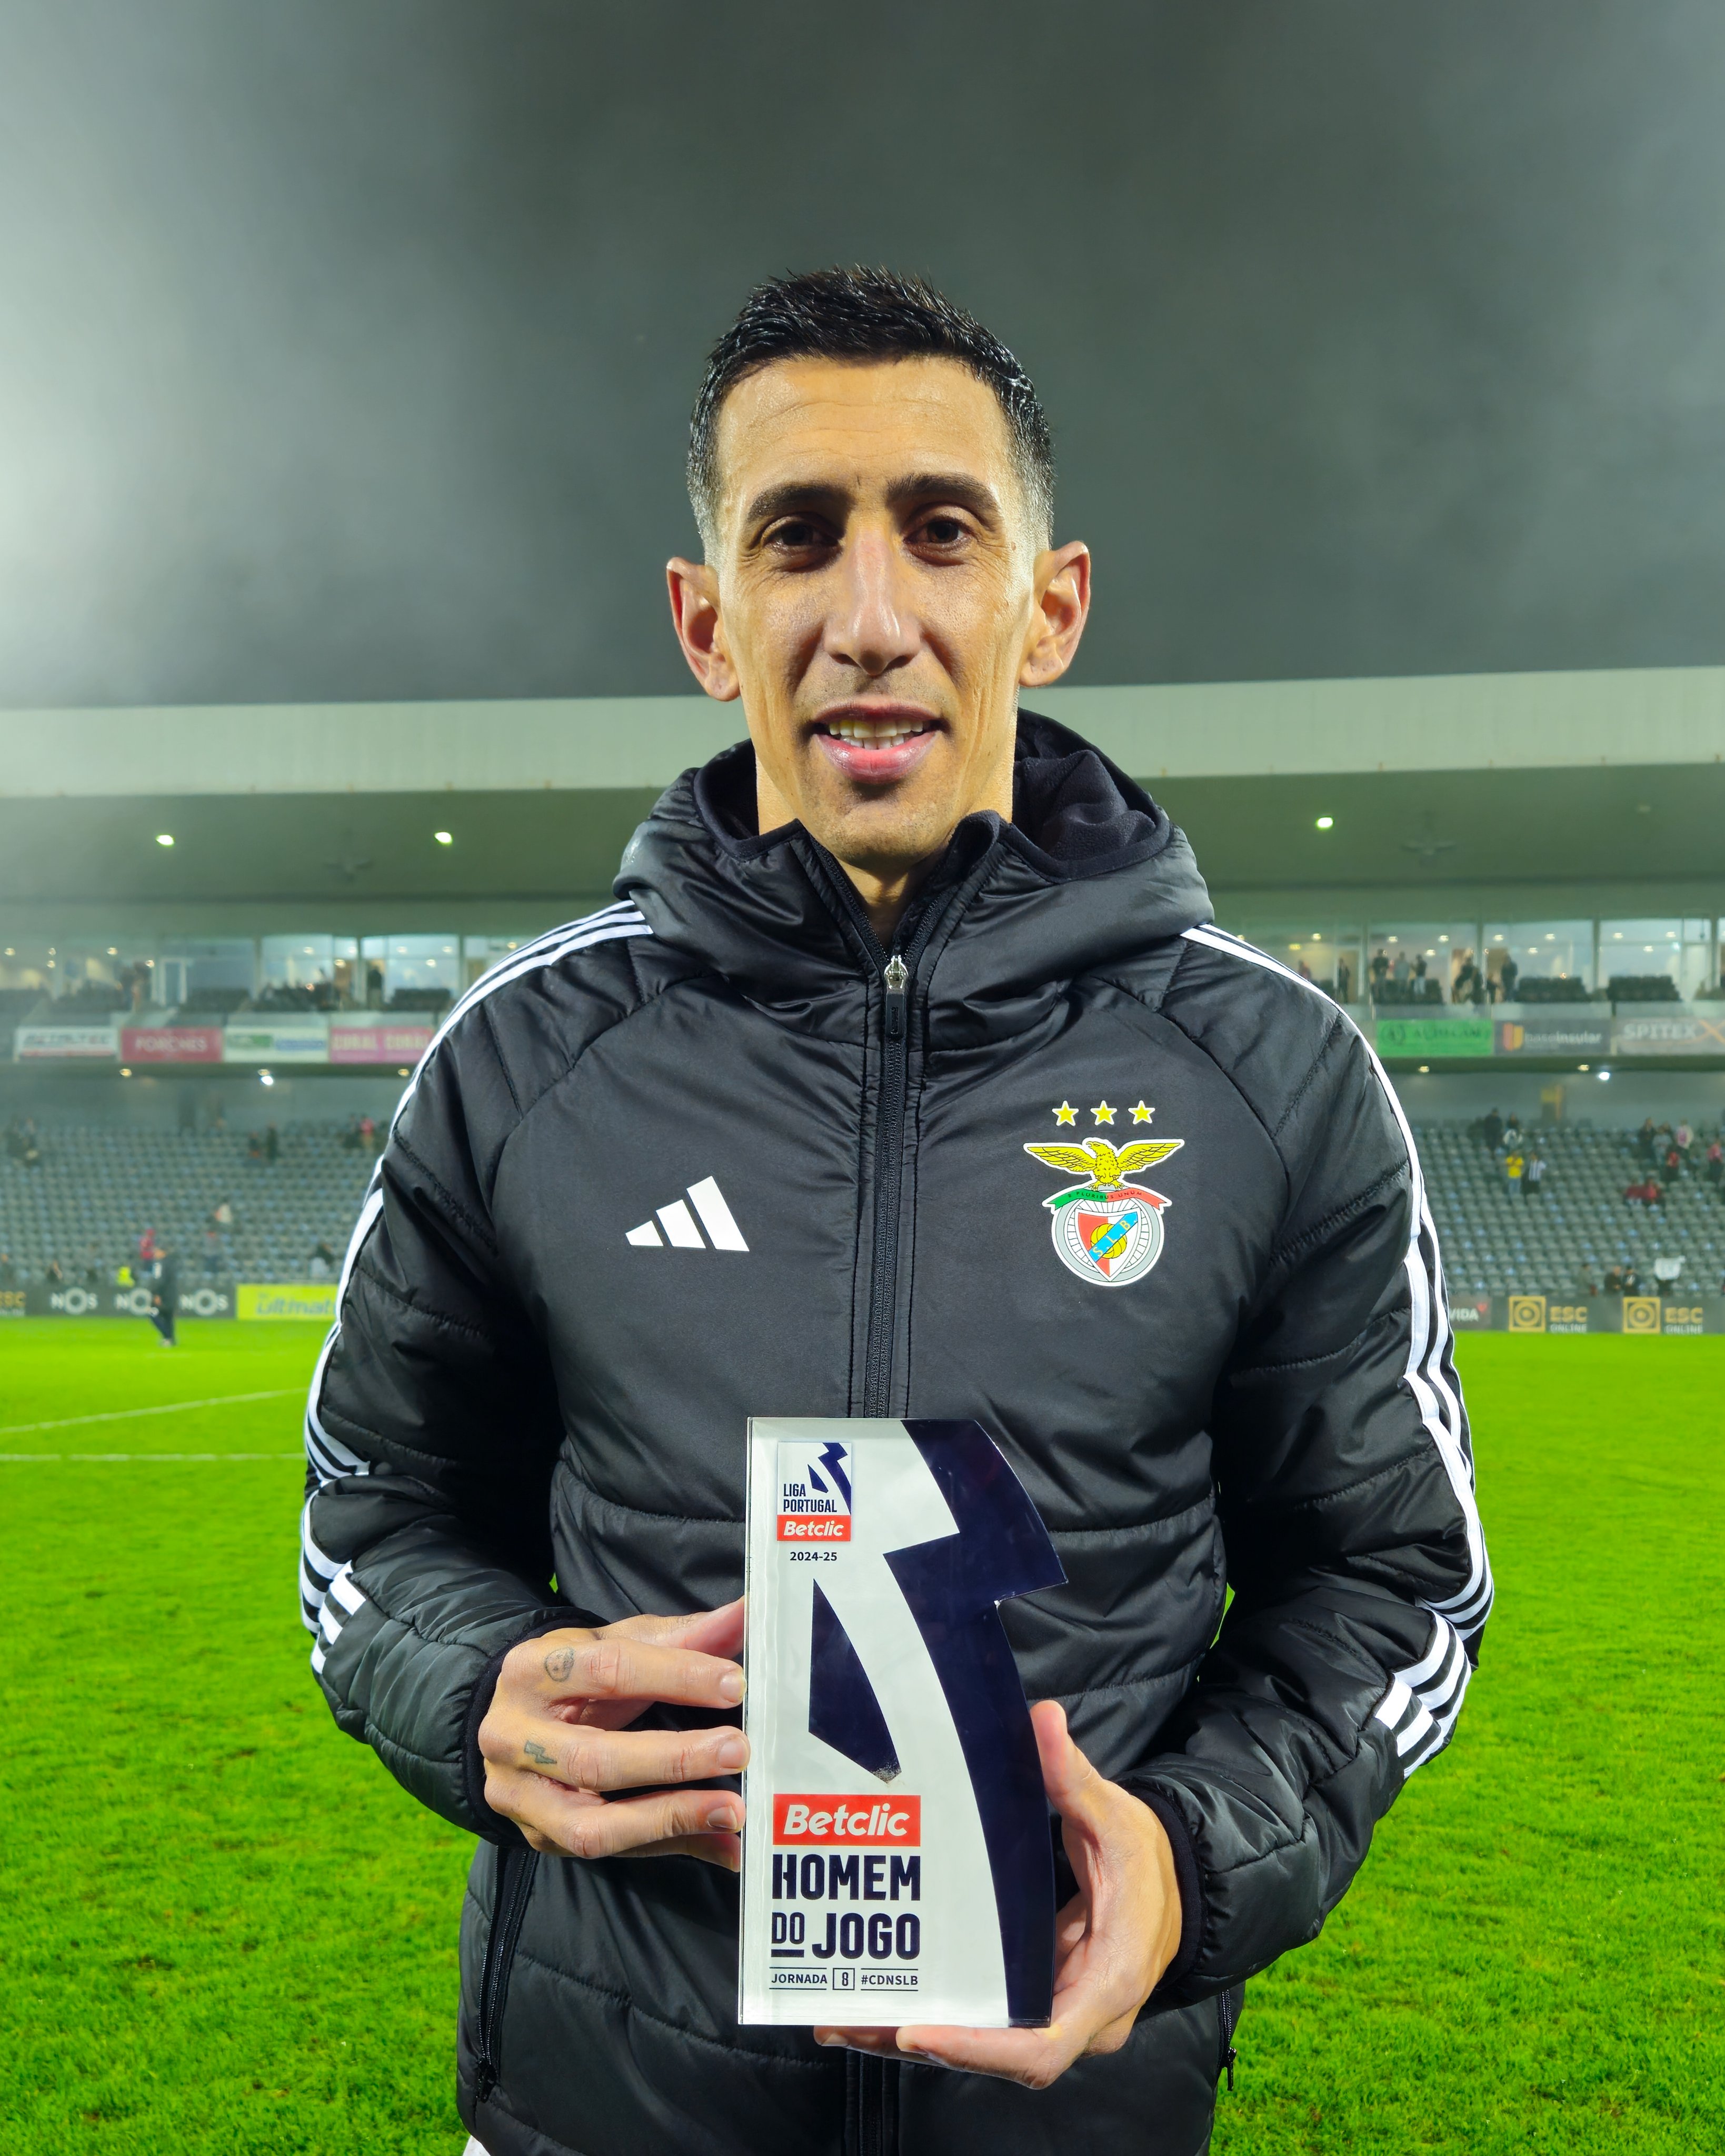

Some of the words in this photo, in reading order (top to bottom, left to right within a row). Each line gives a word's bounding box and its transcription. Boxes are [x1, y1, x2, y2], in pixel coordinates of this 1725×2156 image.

[51, 1287, 97, 1315] NOS
[114, 1288, 152, 1315] NO
[180, 1288, 228, 1315] NOS
[1550, 1306, 1587, 1323] ESC
[1665, 1307, 1703, 1324] ESC
[1550, 1324, 1587, 1333] ONLINE
[1665, 1325, 1703, 1334] ONLINE
[783, 1483, 806, 1497] LIGA
[783, 1499, 837, 1513] PORTUGAL
[783, 1520, 844, 1536] Betclic
[790, 1551, 837, 1562] 2024-25
[783, 1803, 910, 1836] Betclic
[772, 1853, 921, 1901] HOMEM
[771, 1912, 805, 1945] DO
[811, 1912, 921, 1960] JOGO
[771, 1973, 828, 1984] JORNADA
[841, 1971, 850, 1987] 8
[861, 1974, 919, 1986] #CDNSLB
